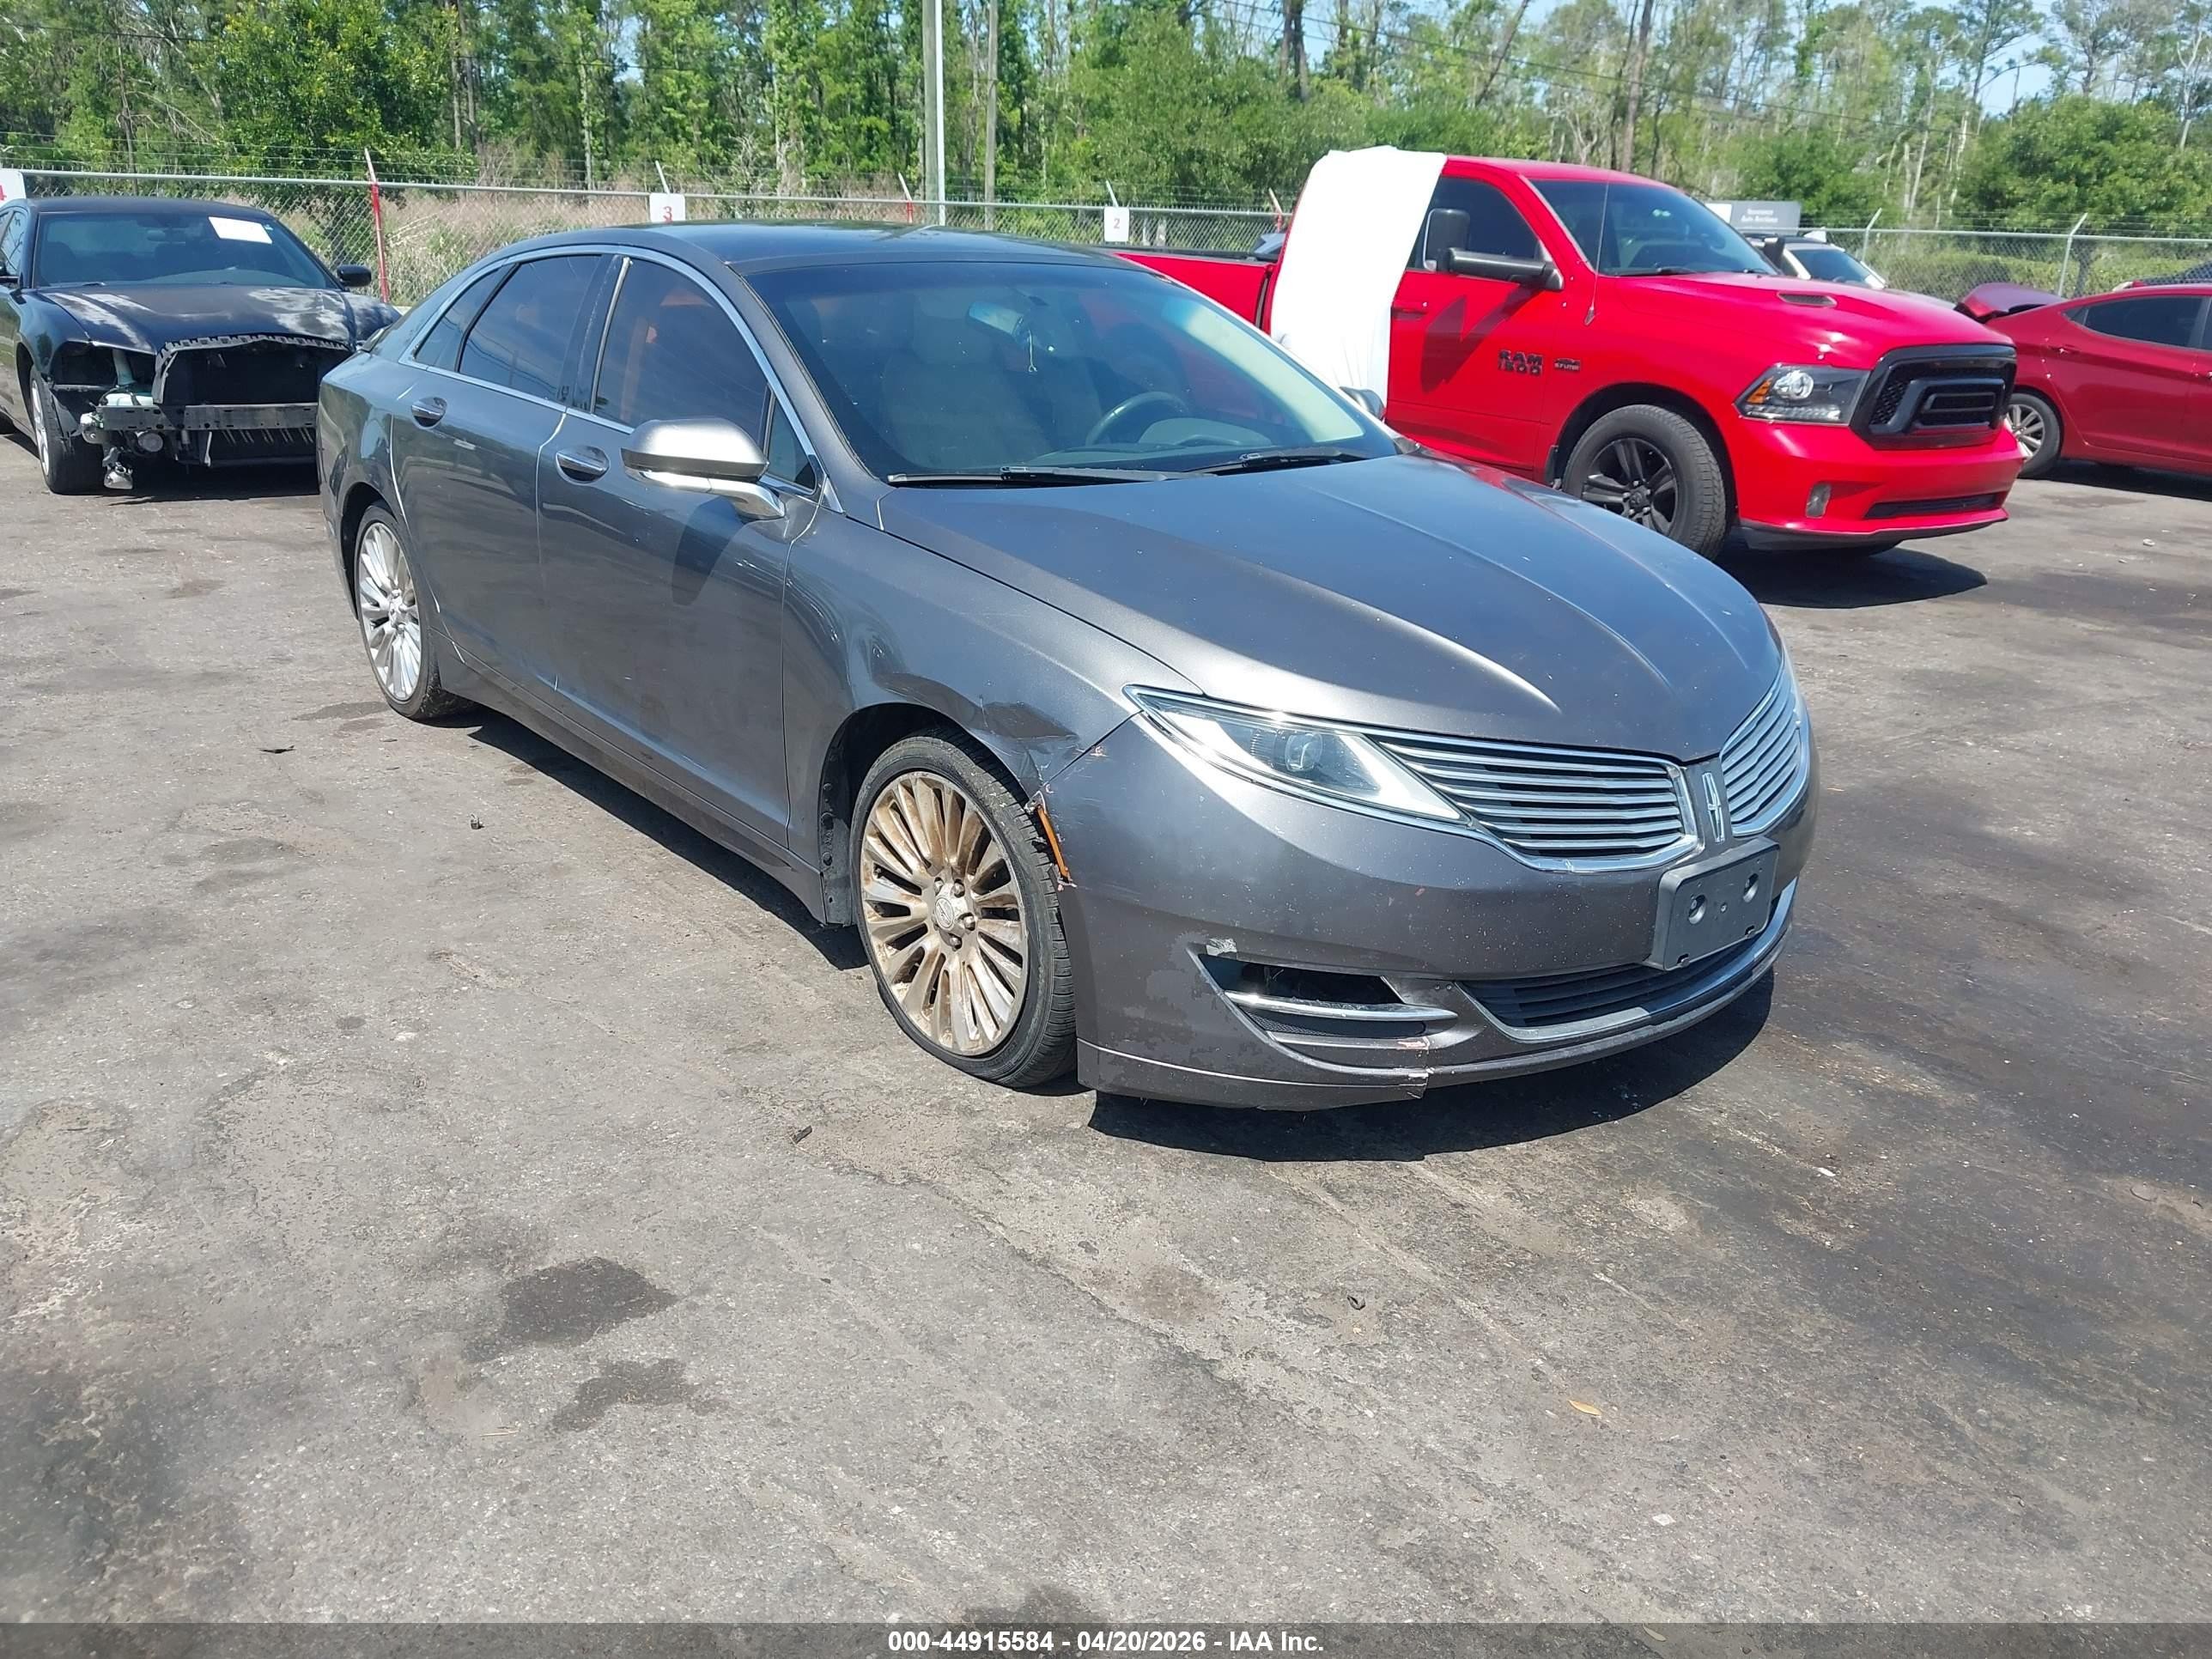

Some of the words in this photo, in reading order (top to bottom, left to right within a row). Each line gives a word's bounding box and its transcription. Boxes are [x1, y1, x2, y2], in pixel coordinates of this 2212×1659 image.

[663, 205, 673, 224] 3
[1113, 217, 1121, 229] 2
[1498, 349, 1543, 366] RAM
